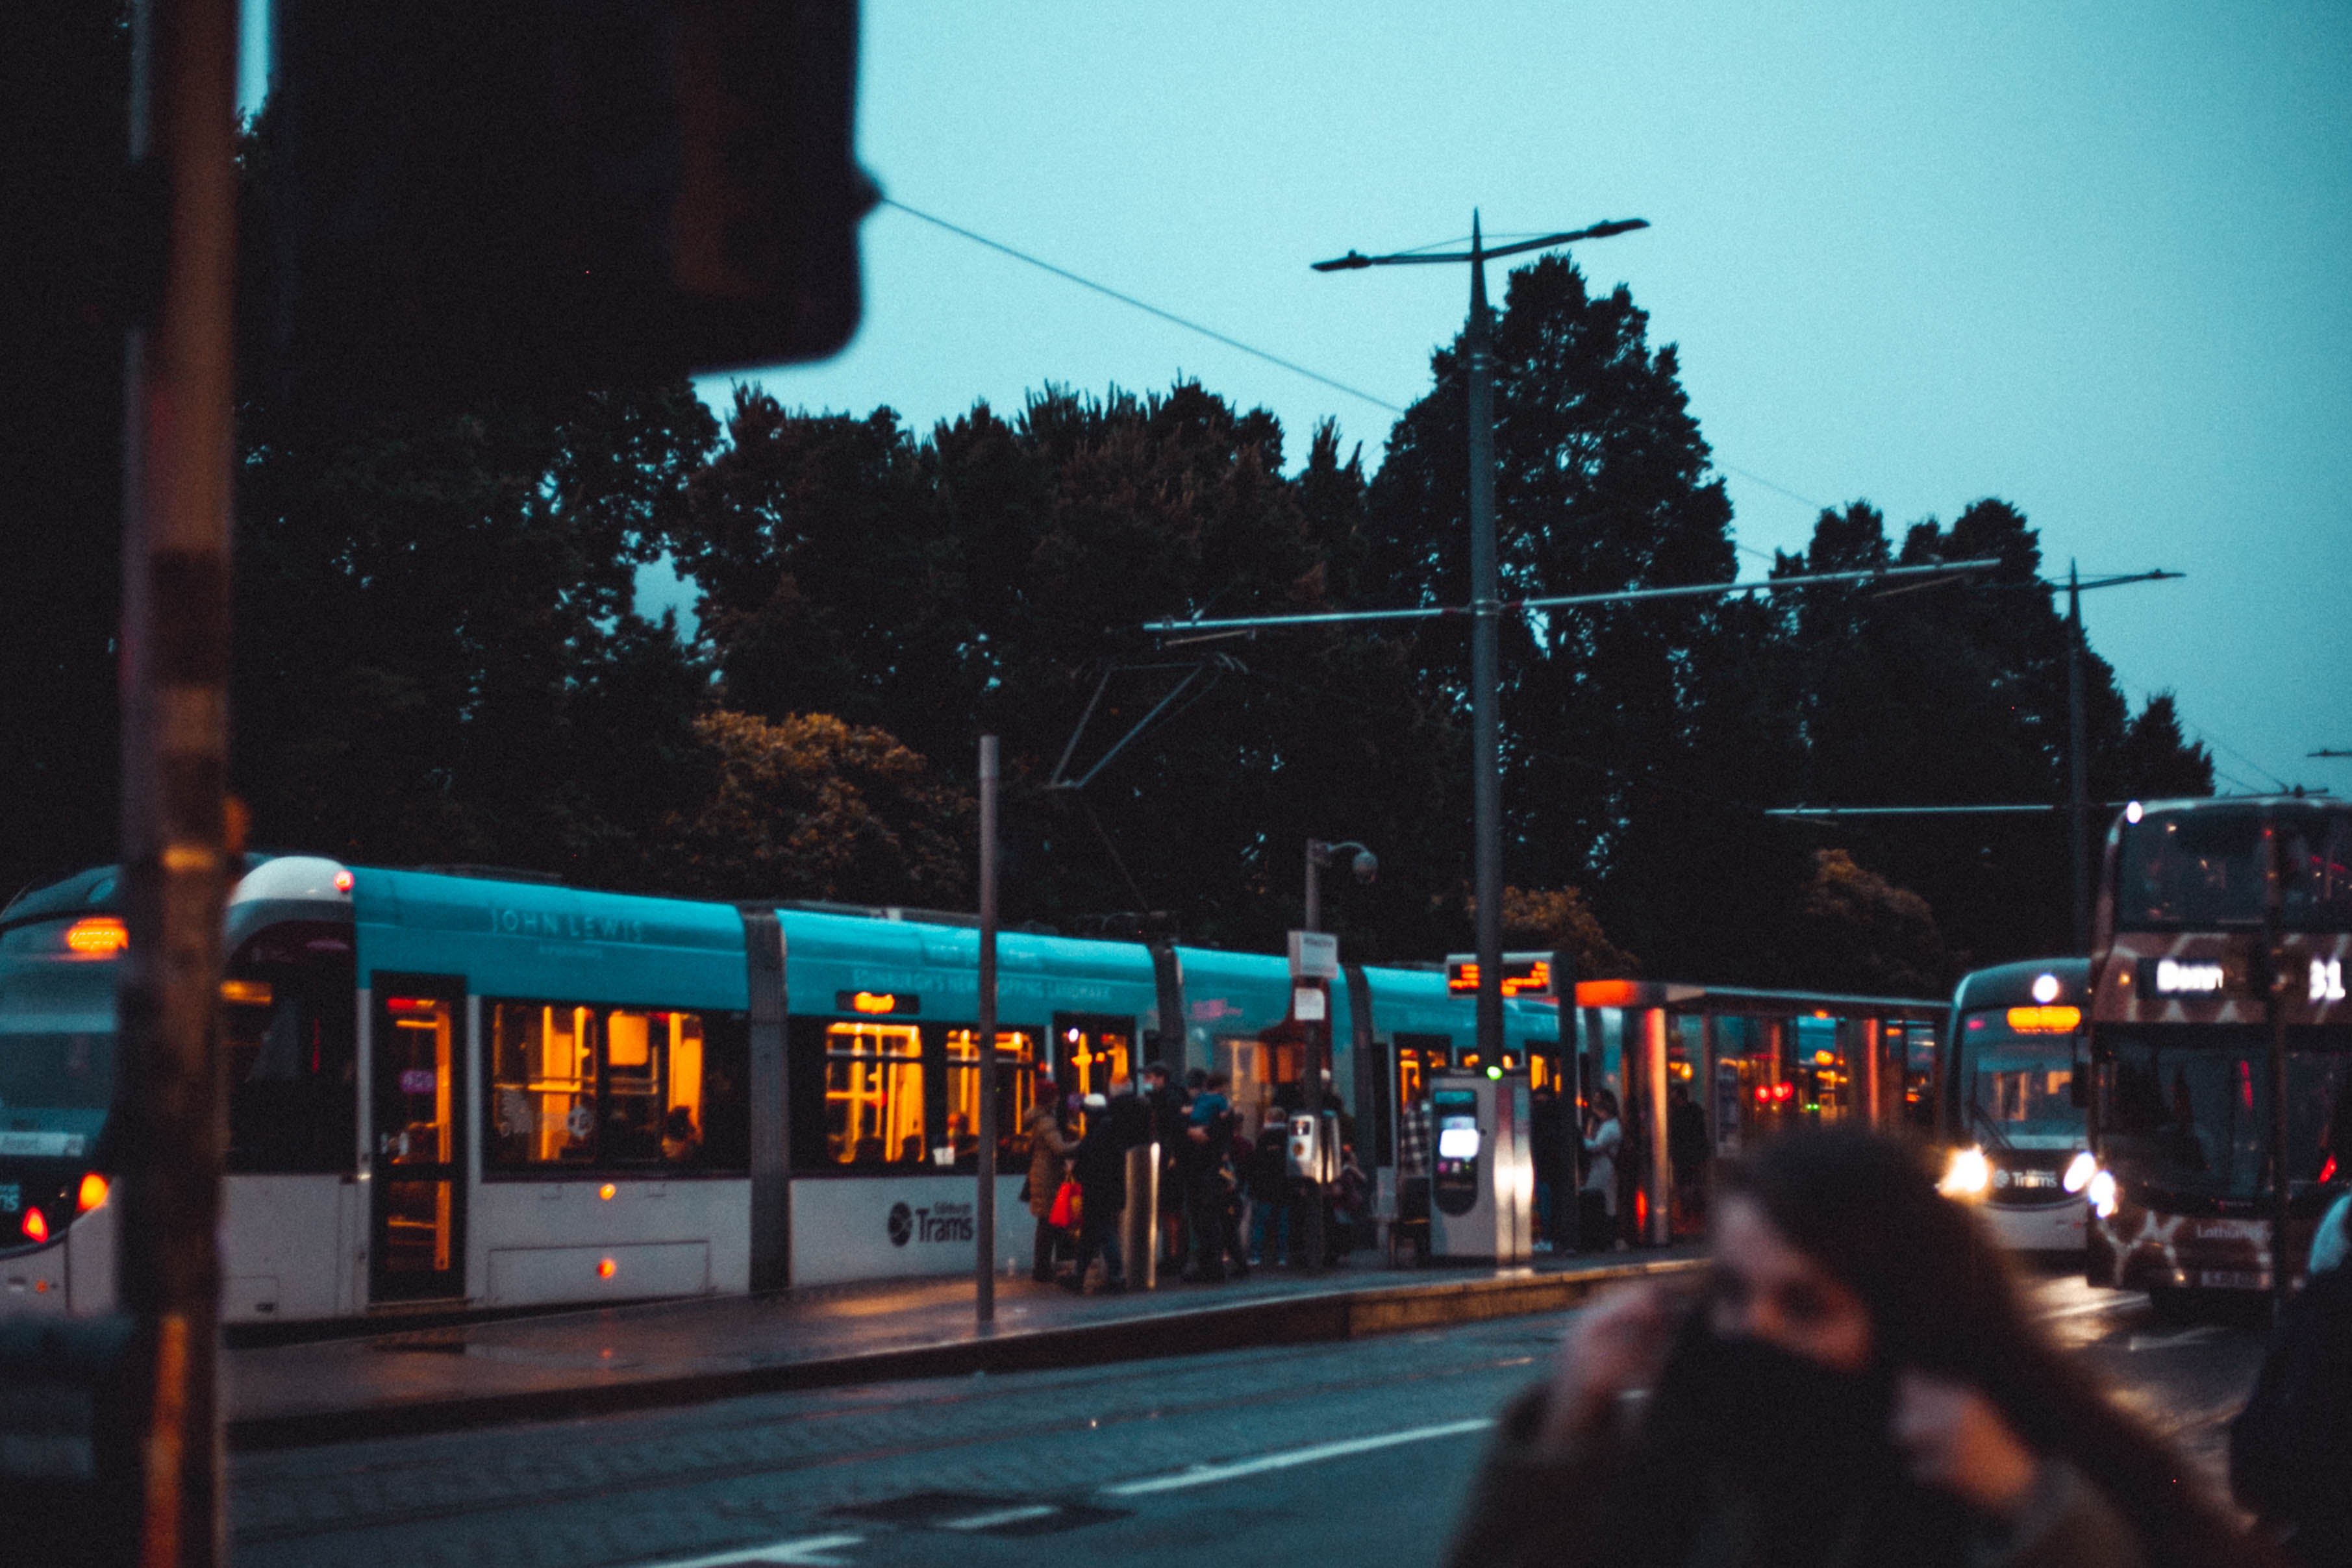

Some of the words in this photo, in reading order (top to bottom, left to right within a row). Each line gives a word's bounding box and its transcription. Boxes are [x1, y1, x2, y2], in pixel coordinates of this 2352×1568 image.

[490, 908, 559, 935] JOHN
[568, 914, 642, 942] LEWIS
[915, 1208, 974, 1242] Trams
